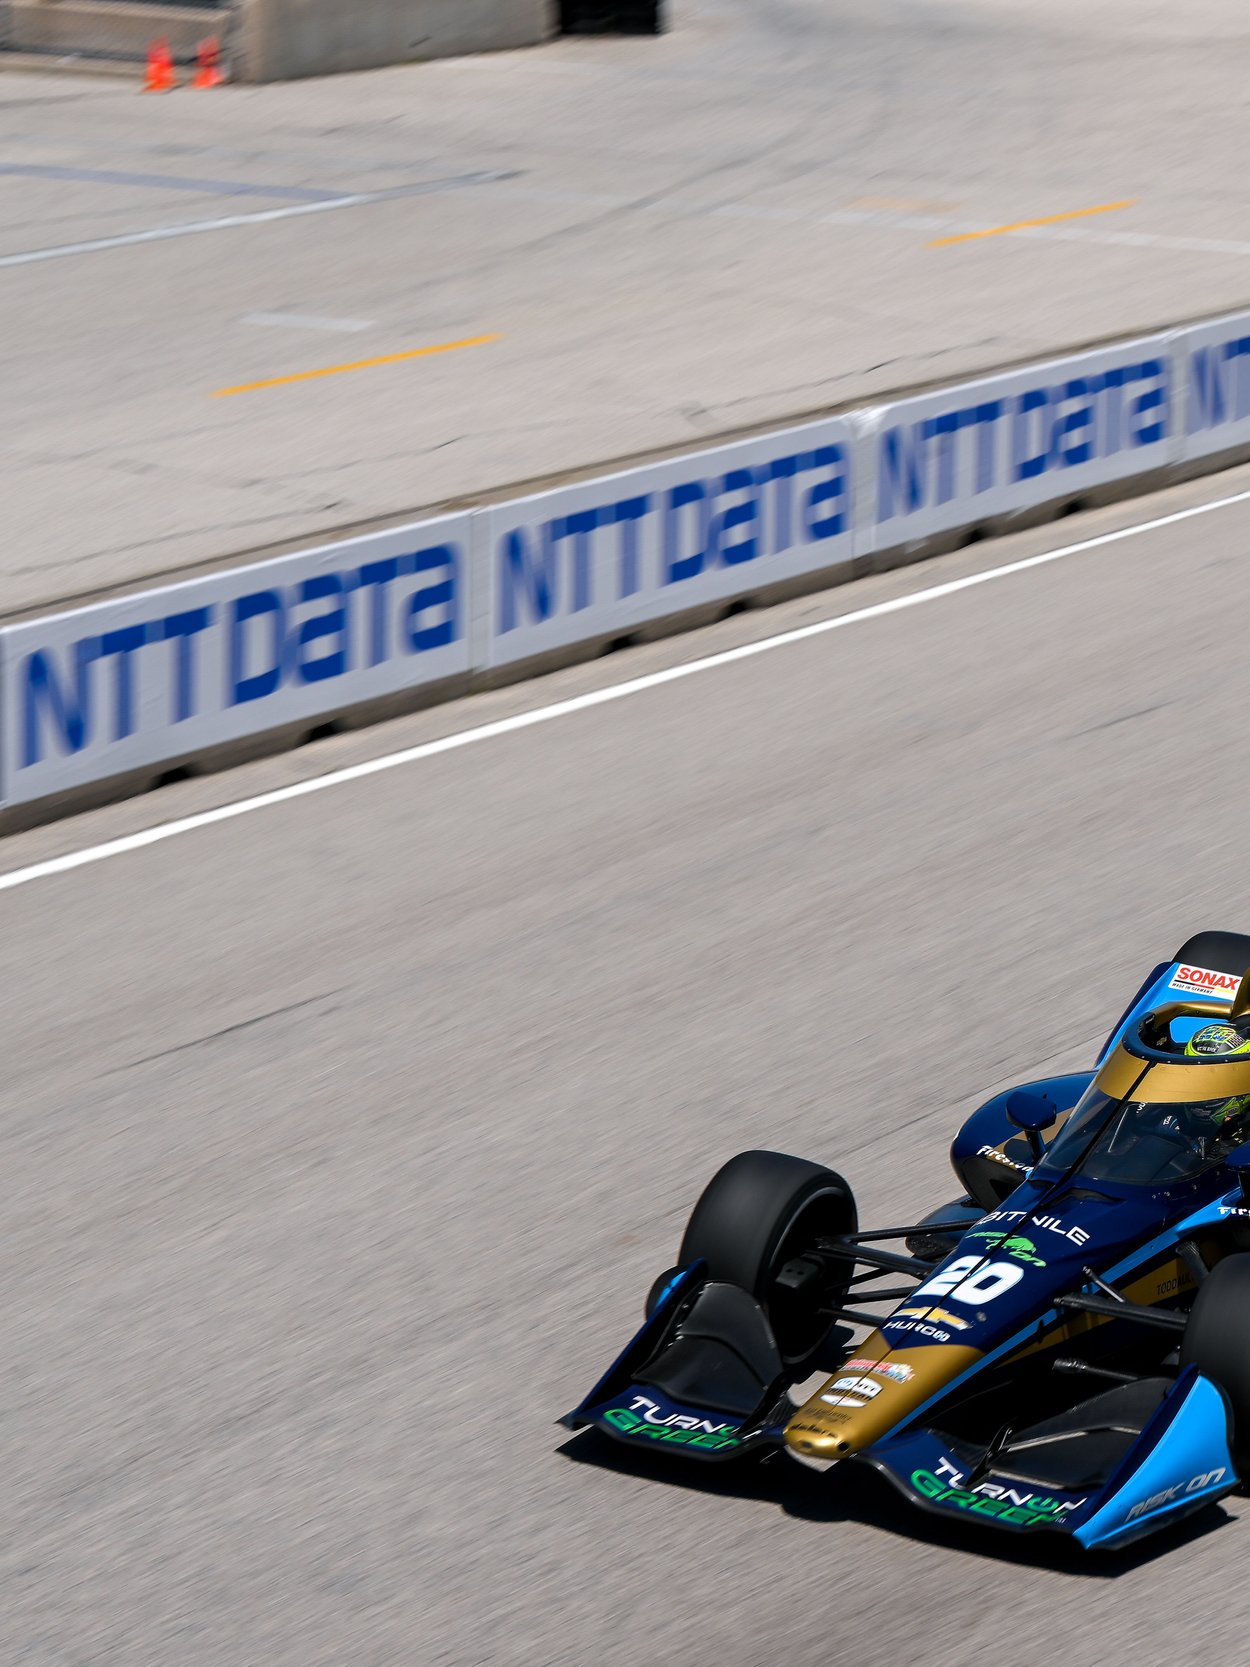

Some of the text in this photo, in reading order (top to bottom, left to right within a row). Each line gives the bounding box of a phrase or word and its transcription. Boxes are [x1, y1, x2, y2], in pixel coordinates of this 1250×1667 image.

[877, 399, 1002, 524] NTT
[497, 490, 661, 635] NTT
[17, 602, 217, 770] NTT
[1177, 967, 1240, 990] SONAX
[911, 1255, 1024, 1305] 20
[629, 1395, 727, 1433] TURN
[911, 1469, 1068, 1526] GREEN
